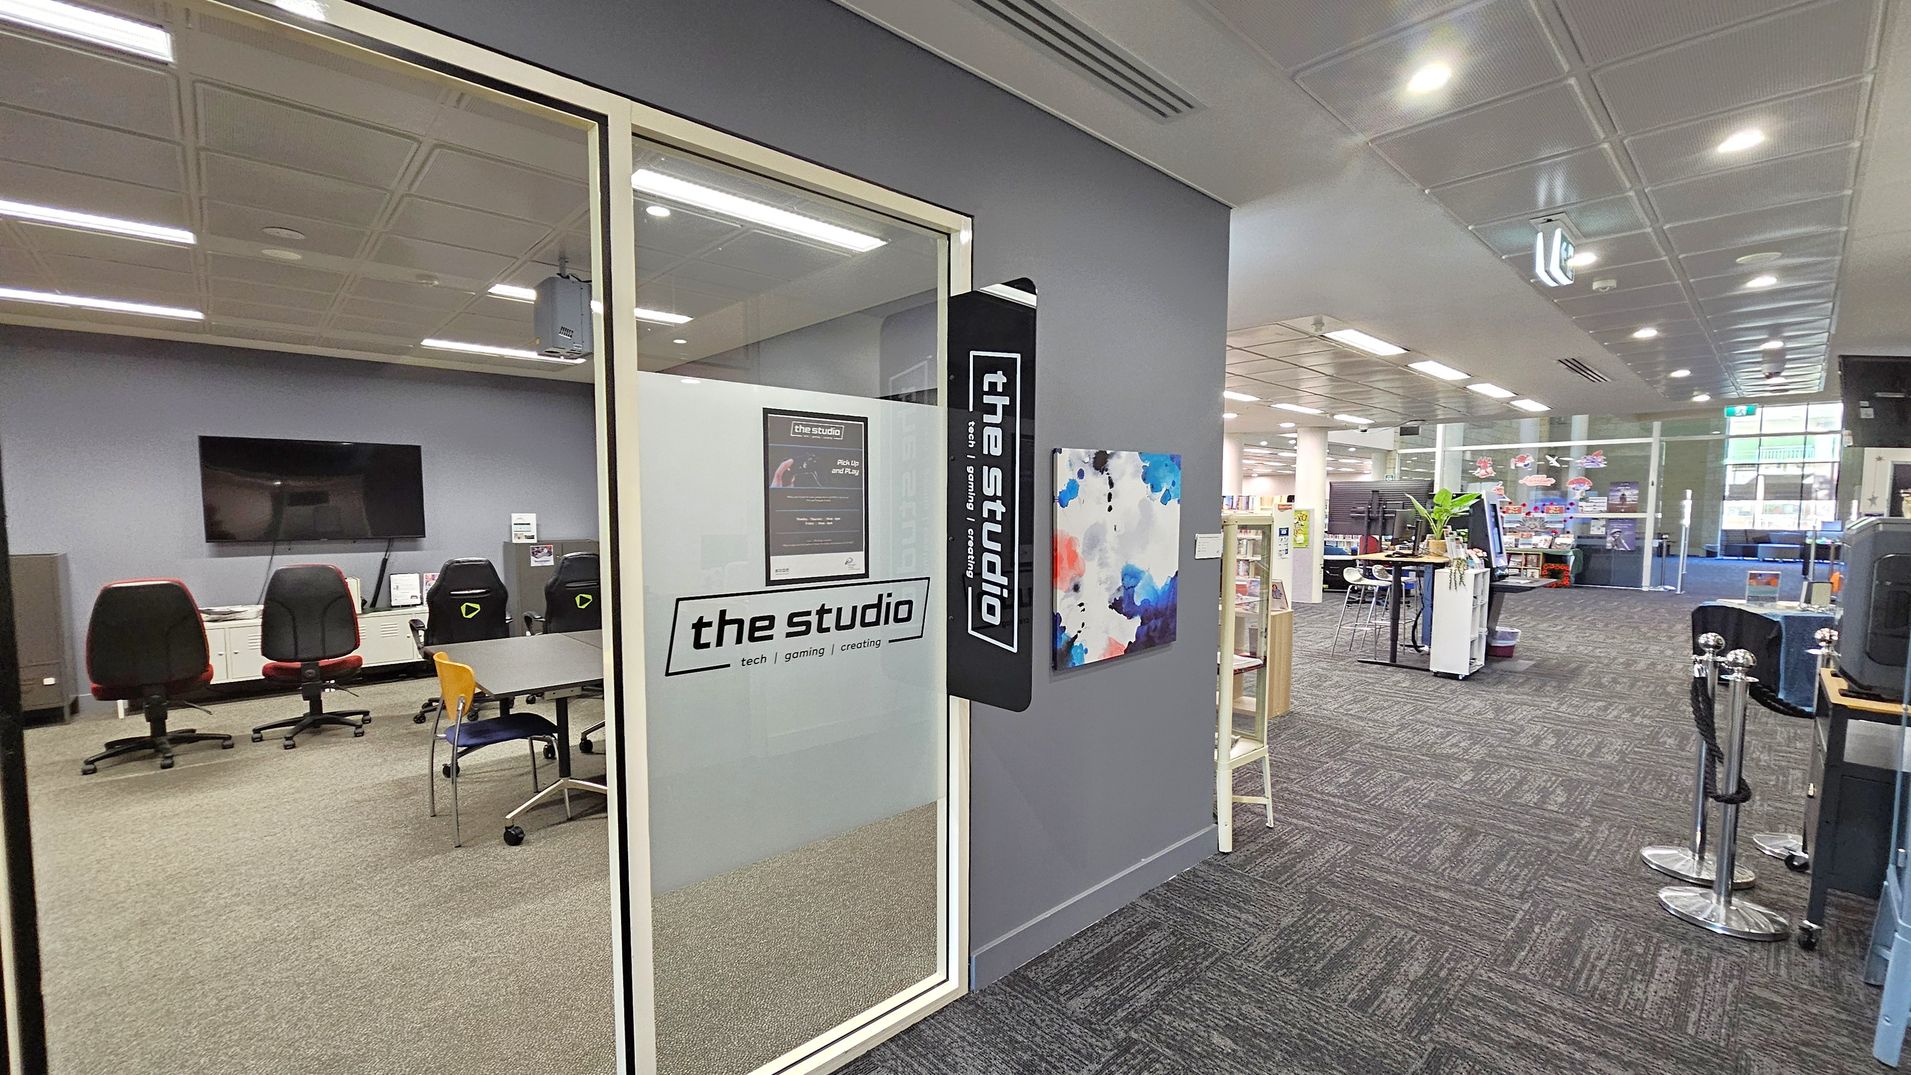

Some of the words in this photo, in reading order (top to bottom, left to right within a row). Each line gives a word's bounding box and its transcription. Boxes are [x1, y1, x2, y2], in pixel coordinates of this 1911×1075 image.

[794, 424, 811, 434] the
[812, 427, 841, 436] studio
[968, 421, 976, 448] tech
[983, 370, 1010, 456] the
[850, 460, 860, 468] Up
[966, 465, 976, 511] gaming
[966, 528, 976, 579] creating
[982, 466, 1008, 626] studio
[691, 608, 776, 651] the
[785, 592, 914, 639] studio
[741, 654, 767, 667] tech
[784, 647, 825, 662] gaming
[840, 638, 881, 651] creating
